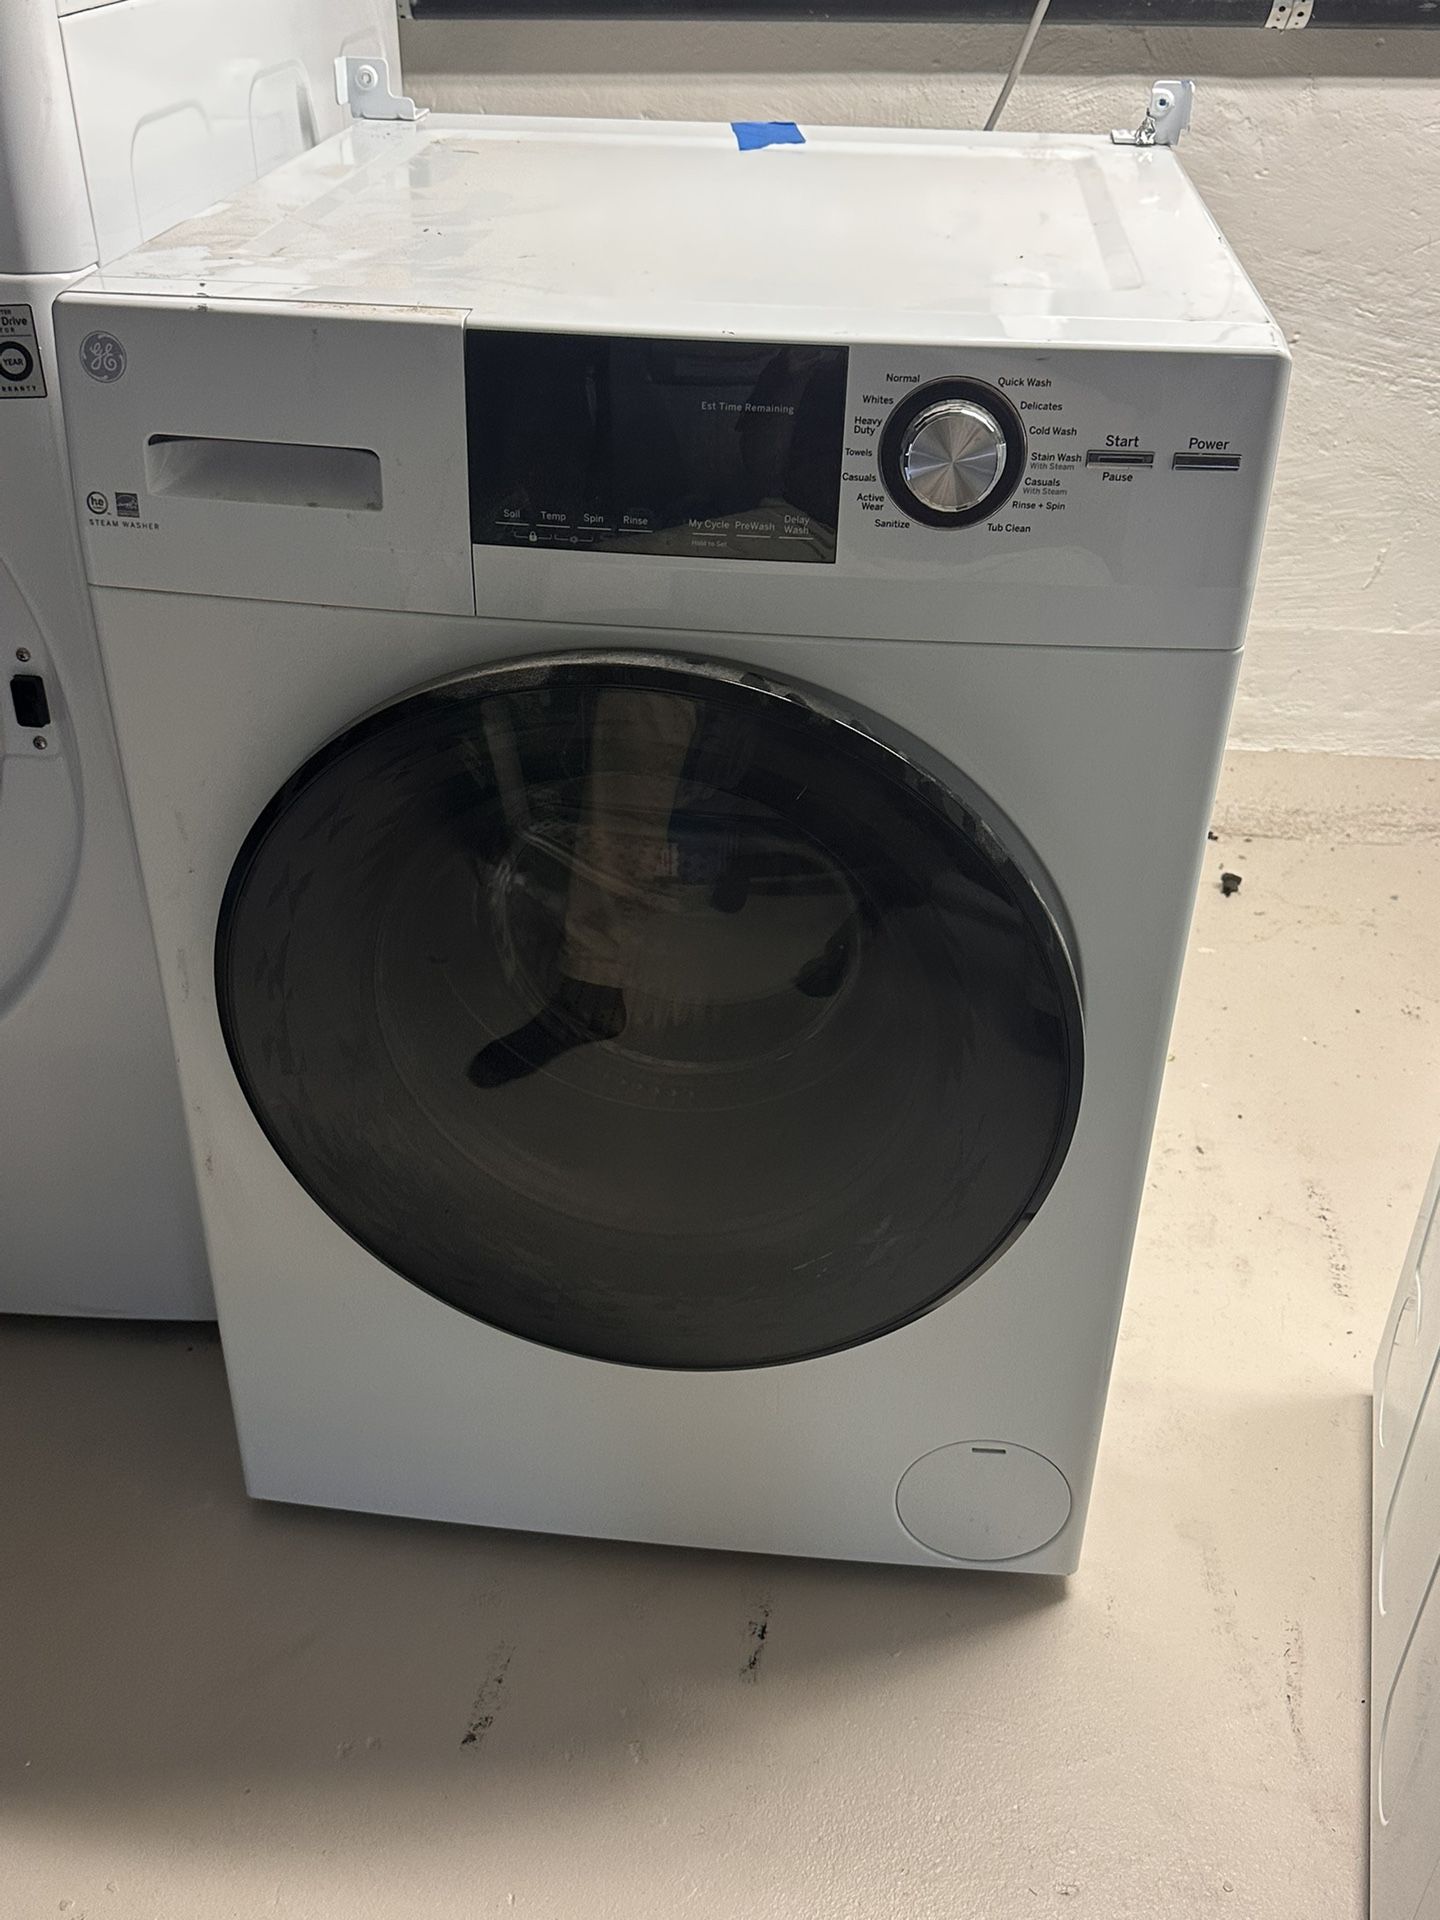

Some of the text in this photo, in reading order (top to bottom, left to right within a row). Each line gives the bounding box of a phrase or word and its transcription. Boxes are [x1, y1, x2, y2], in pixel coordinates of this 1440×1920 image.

[2, 316, 28, 326] Drive
[3, 358, 24, 366] YEAR
[886, 373, 920, 383] Normal
[998, 377, 1052, 387] Quick Wash
[862, 395, 894, 405] Whites
[701, 401, 795, 415] Est Time Remaining
[1020, 401, 1063, 411] Delicates
[854, 416, 882, 427] Heavy
[854, 425, 876, 436] Duty
[1029, 426, 1078, 436] Cold Wash
[1105, 434, 1140, 448] Start
[1189, 437, 1230, 450] Power
[845, 447, 873, 457] Towels
[1031, 452, 1082, 462] Stain Wash
[1030, 462, 1075, 471] With Steam
[842, 472, 877, 482] Casuals
[1102, 471, 1134, 482] Pause
[1024, 477, 1061, 487] Casuals
[1023, 487, 1068, 496] With Steam
[857, 493, 885, 502] Active
[861, 502, 884, 511] Wear
[1012, 500, 1037, 510] Rinse
[1046, 502, 1066, 511] Spin
[503, 509, 521, 519] Soil
[540, 511, 567, 521] Temp
[583, 513, 604, 523] Spin
[89, 519, 160, 530] STEAM WASHER
[623, 515, 649, 526] Rinse
[688, 519, 730, 530] My Cycle
[784, 515, 810, 525] Delay
[874, 519, 911, 529] Sanitize
[735, 521, 776, 531] PreWash
[784, 525, 809, 535] Wash
[987, 523, 1031, 533] Tub Clean
